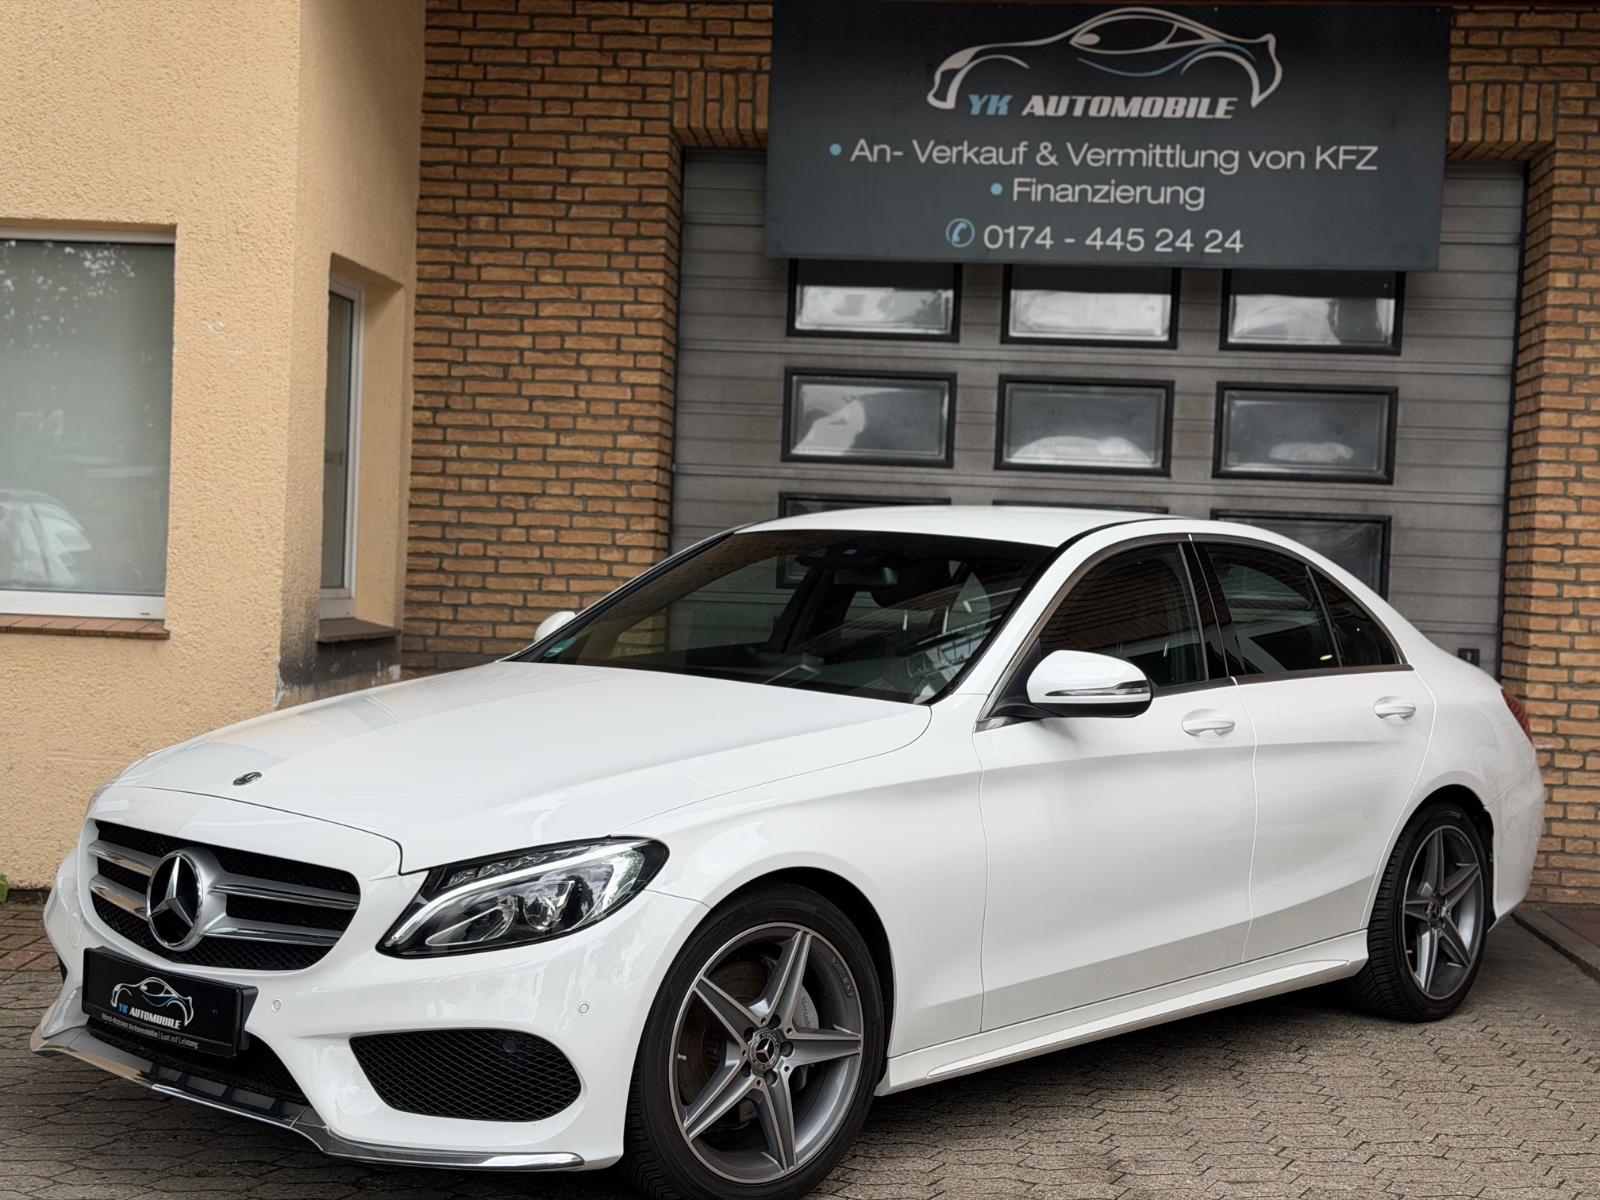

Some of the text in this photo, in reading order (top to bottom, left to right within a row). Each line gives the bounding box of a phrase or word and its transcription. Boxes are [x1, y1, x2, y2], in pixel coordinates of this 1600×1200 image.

[969, 95, 1238, 119] YK AUTOMOBILE
[850, 138, 1379, 175] An- Verkauf & Vermittlung von KFZ
[1012, 177, 1205, 212] Finanzierung
[983, 224, 1055, 250] 0174
[1084, 226, 1145, 253] 445
[1154, 227, 1195, 253] 24
[1203, 228, 1245, 254] 24
[118, 1003, 128, 1014] YK
[129, 1007, 182, 1029] AUTOMOBILE
